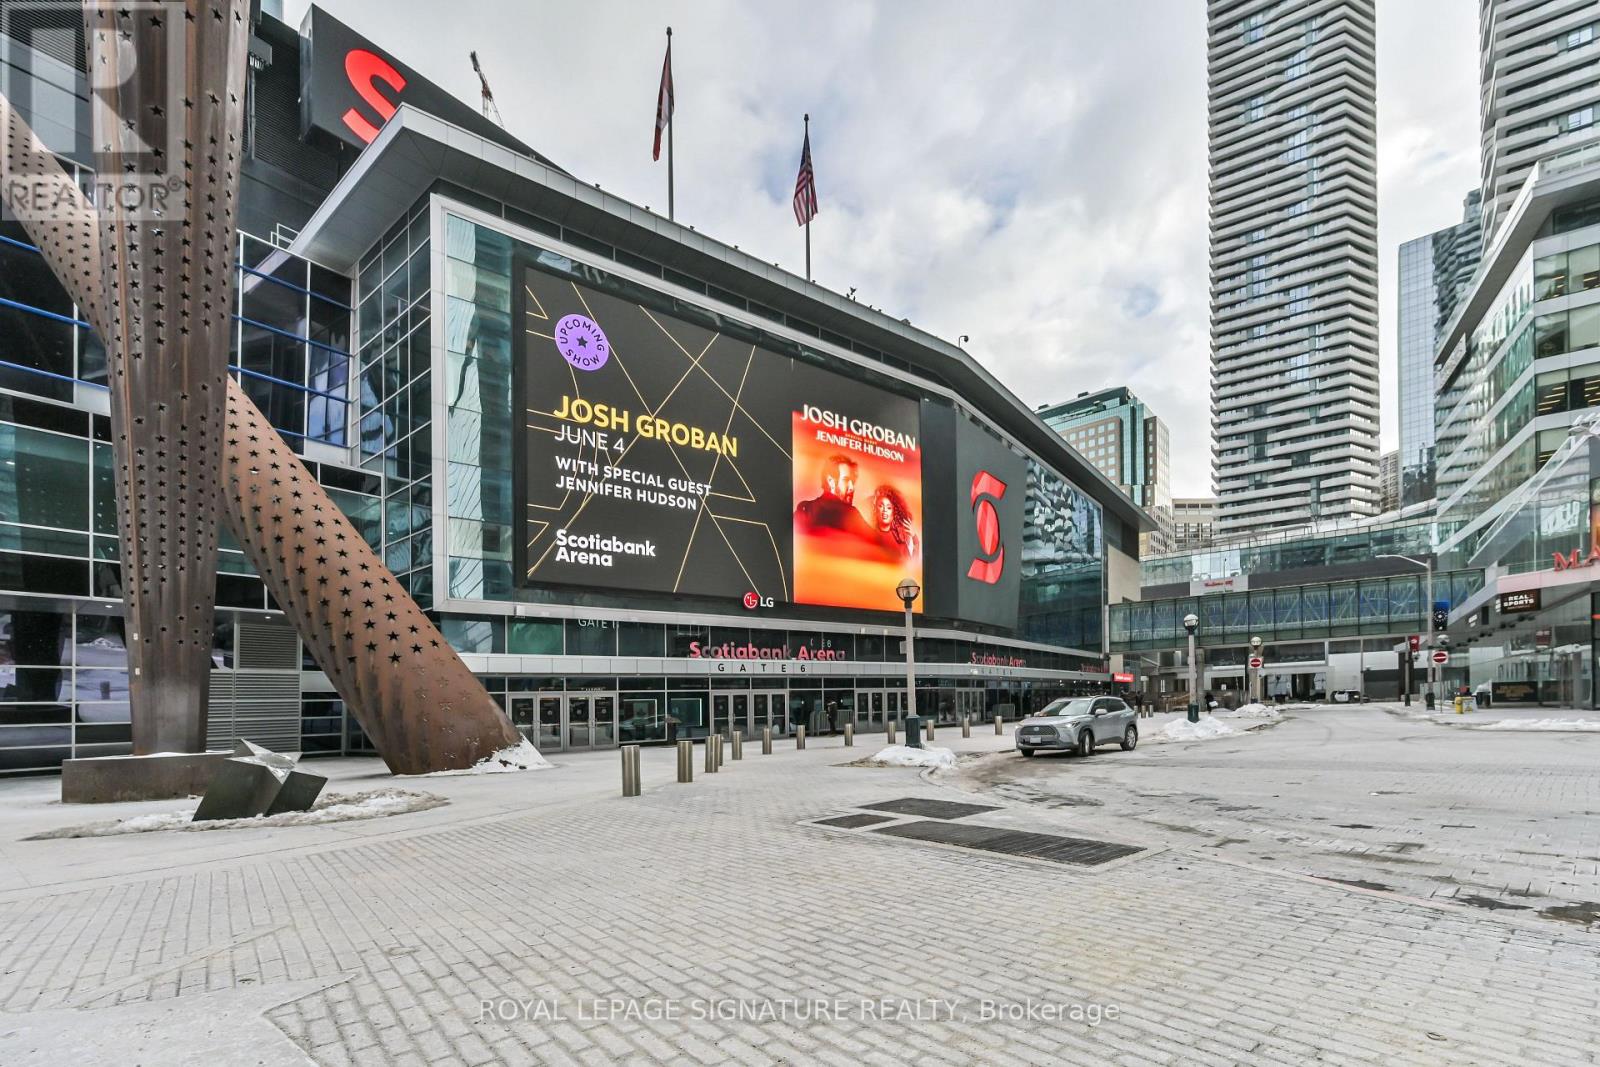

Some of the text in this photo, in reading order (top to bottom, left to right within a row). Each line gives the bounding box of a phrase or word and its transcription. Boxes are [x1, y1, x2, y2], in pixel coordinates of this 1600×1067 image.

[560, 319, 605, 351] UPCOMING
[566, 349, 600, 366] SHOW
[553, 395, 737, 457] JOSH GROBAN
[554, 424, 625, 454] JUNE 4
[801, 404, 847, 431] JOSH
[850, 419, 916, 451] GROBAN
[816, 430, 862, 451] JENNIFER
[863, 444, 904, 462] HUDSON
[555, 455, 711, 496] WITH SPECIAL GUEST
[555, 475, 697, 510] JENNIFER HUDSON
[555, 546, 613, 567] Arena
[556, 528, 656, 557] Scotiabank
[760, 596, 774, 607] LG
[1503, 598, 1534, 607] SPORTS
[689, 641, 792, 660] Scotiabank
[797, 645, 845, 661] Arena
[717, 663, 806, 673] GATE 6
